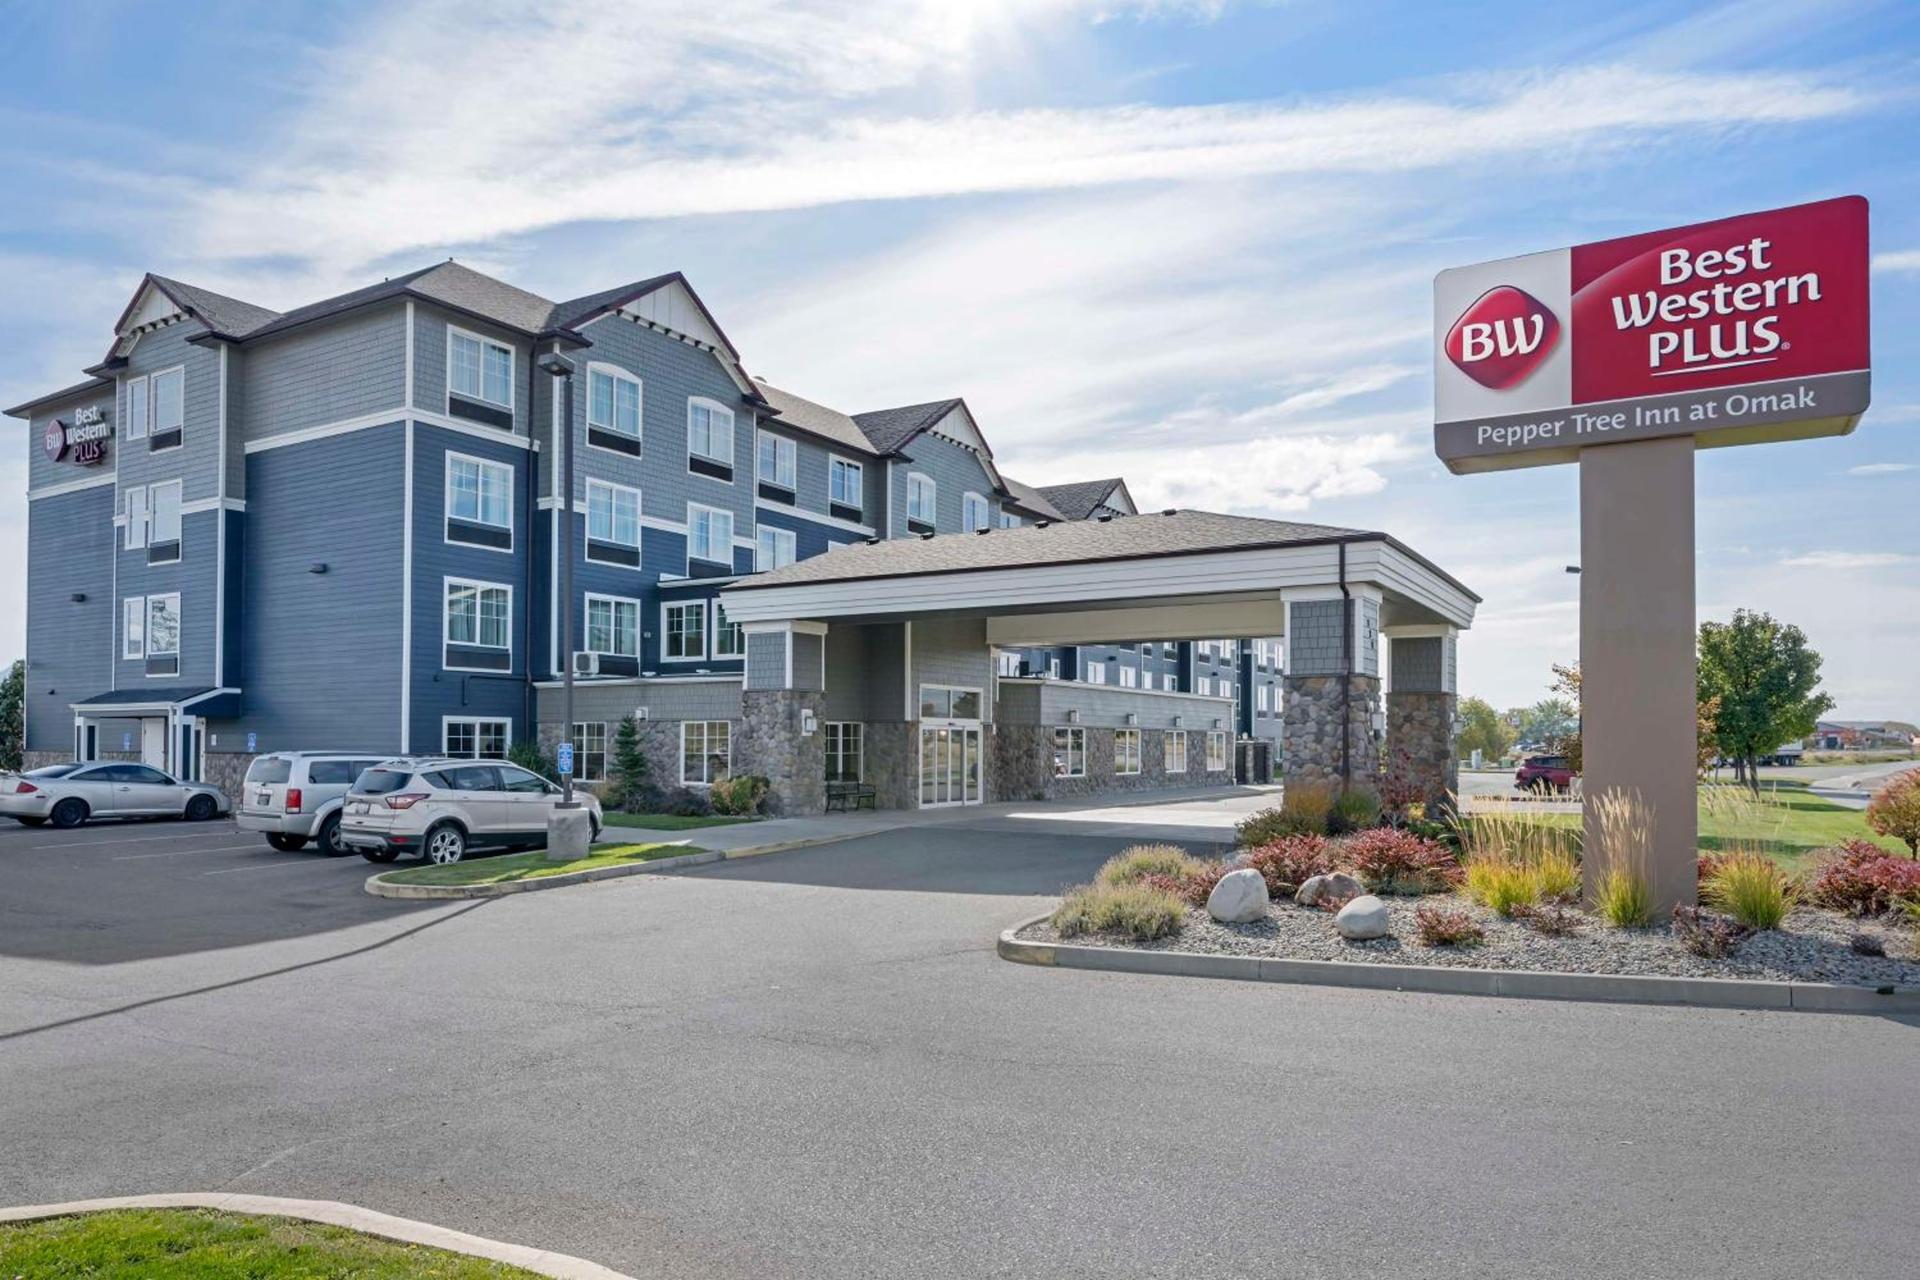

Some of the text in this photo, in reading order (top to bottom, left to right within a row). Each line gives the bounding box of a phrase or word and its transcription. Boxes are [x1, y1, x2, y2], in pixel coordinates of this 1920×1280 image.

[1660, 237, 1772, 286] Best
[1611, 272, 1822, 331] Western
[1462, 313, 1544, 363] BW
[75, 405, 98, 425] Best
[1477, 386, 1816, 447] Pepper Tree Inn at Omak
[46, 431, 62, 451] BW
[65, 422, 107, 446] Western
[73, 440, 100, 461] PLUS
